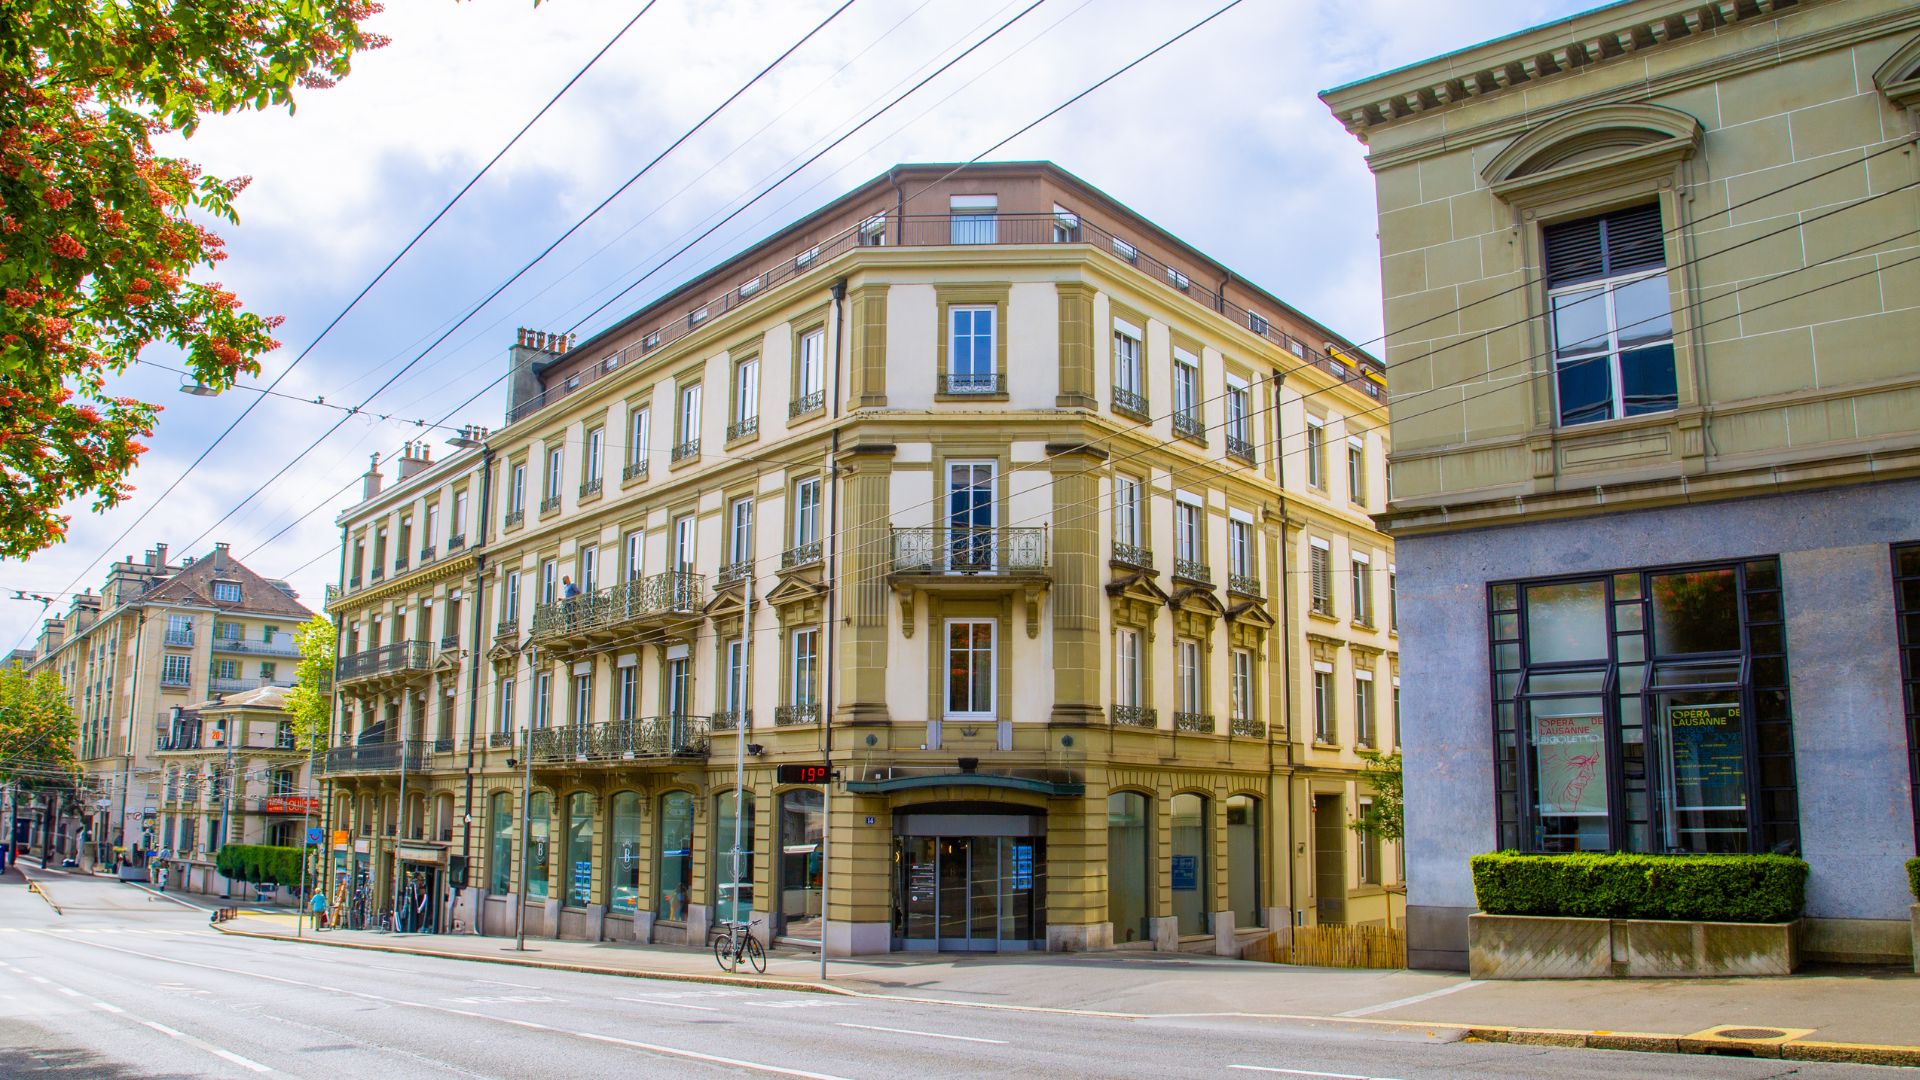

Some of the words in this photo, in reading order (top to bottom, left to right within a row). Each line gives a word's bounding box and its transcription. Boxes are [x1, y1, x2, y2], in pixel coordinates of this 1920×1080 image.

[1728, 708, 1740, 717] DE
[1591, 717, 1603, 725] DE
[1672, 717, 1727, 727] LAUSANNE
[1540, 726, 1590, 736] LAUSANNE
[1539, 734, 1600, 744] RIGOLETTO
[802, 767, 825, 782] 19°
